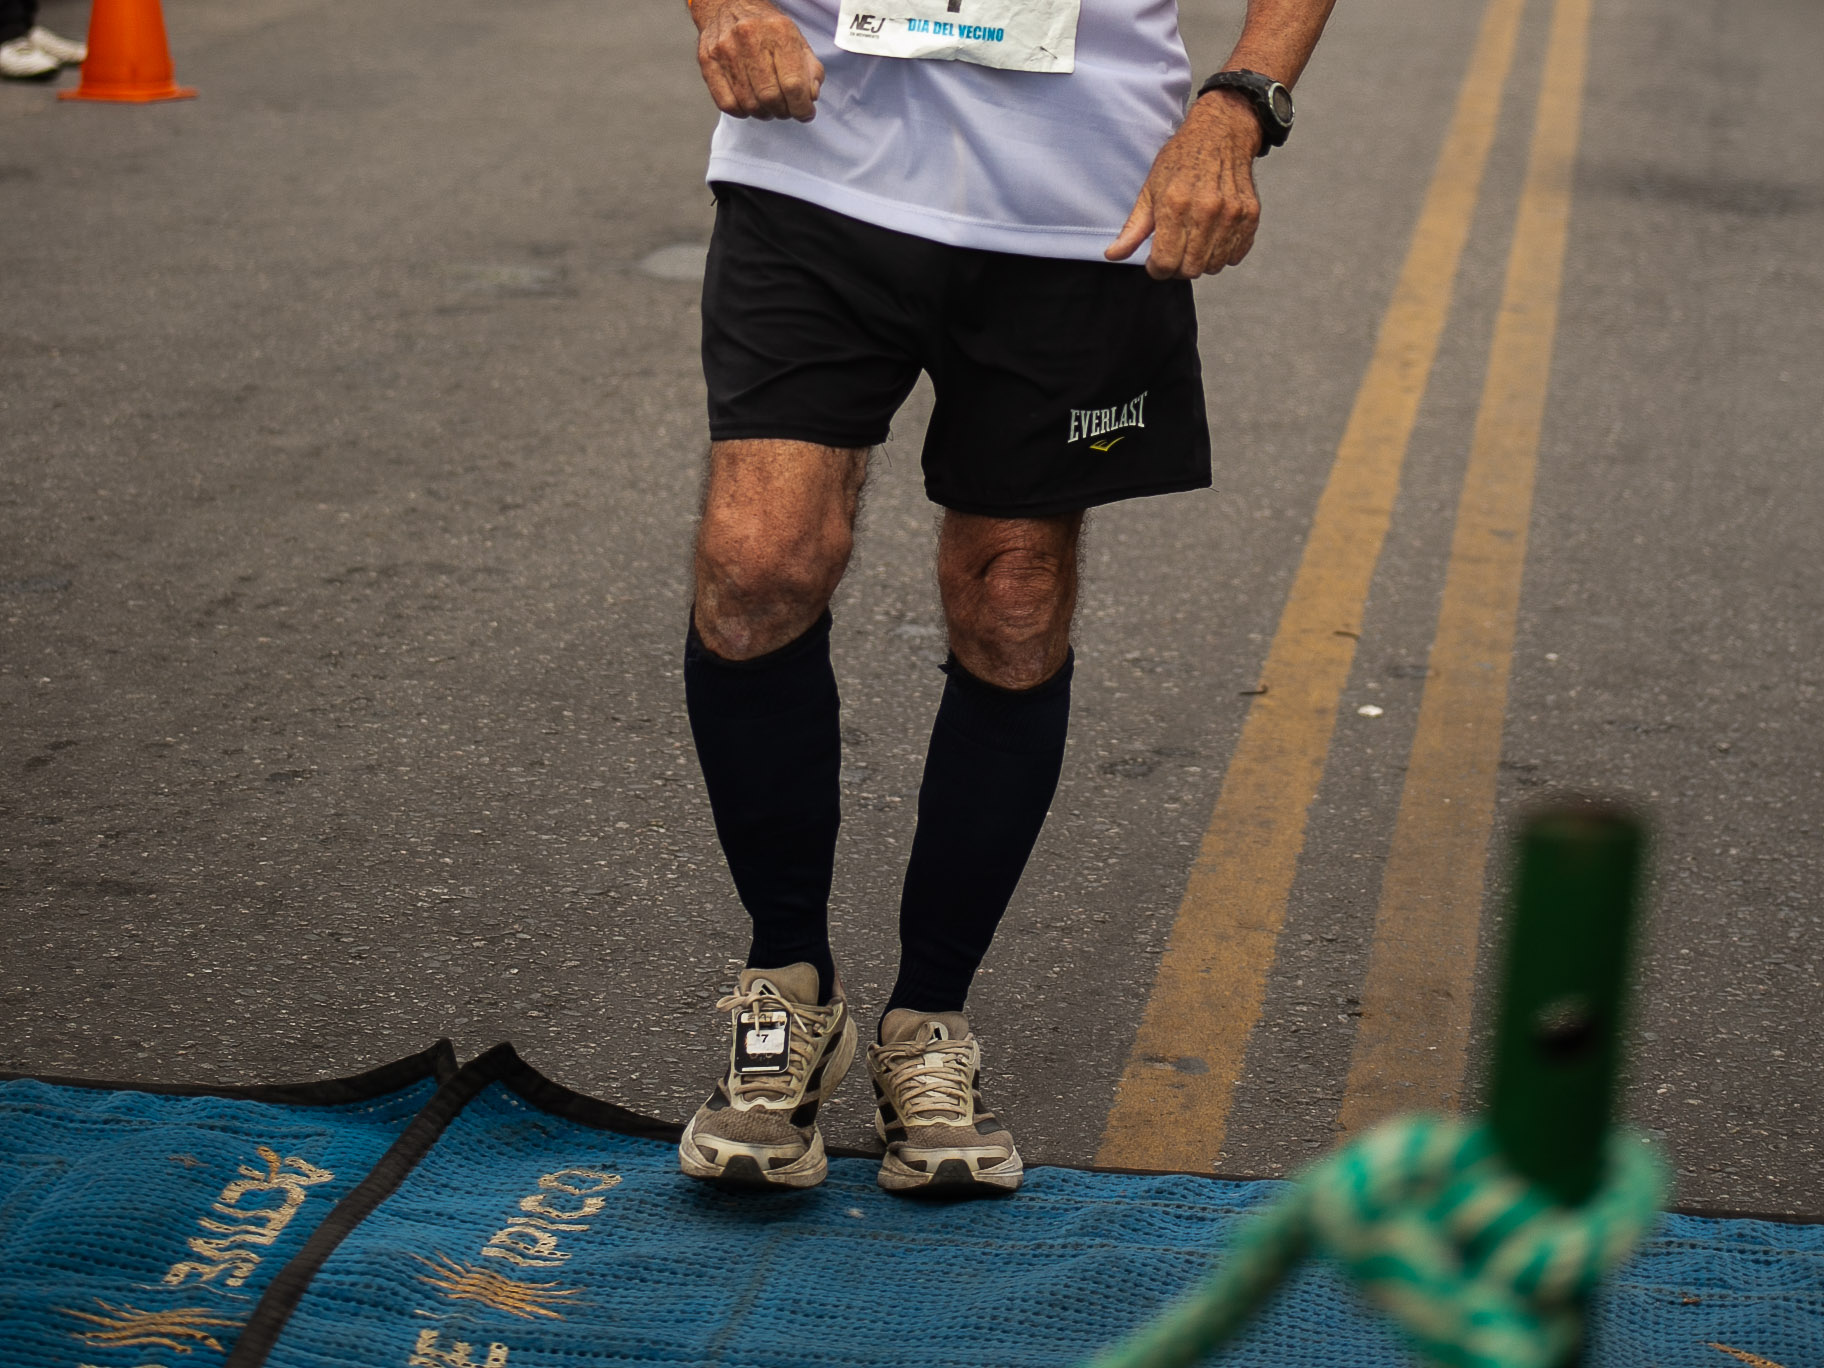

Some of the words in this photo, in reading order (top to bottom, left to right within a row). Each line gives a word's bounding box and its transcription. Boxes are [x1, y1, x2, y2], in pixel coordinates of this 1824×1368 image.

[850, 13, 886, 33] NEJ
[908, 18, 930, 33] DIA
[933, 21, 954, 36] DEL
[958, 24, 1005, 42] VECINO
[1067, 390, 1148, 443] EVERLAST
